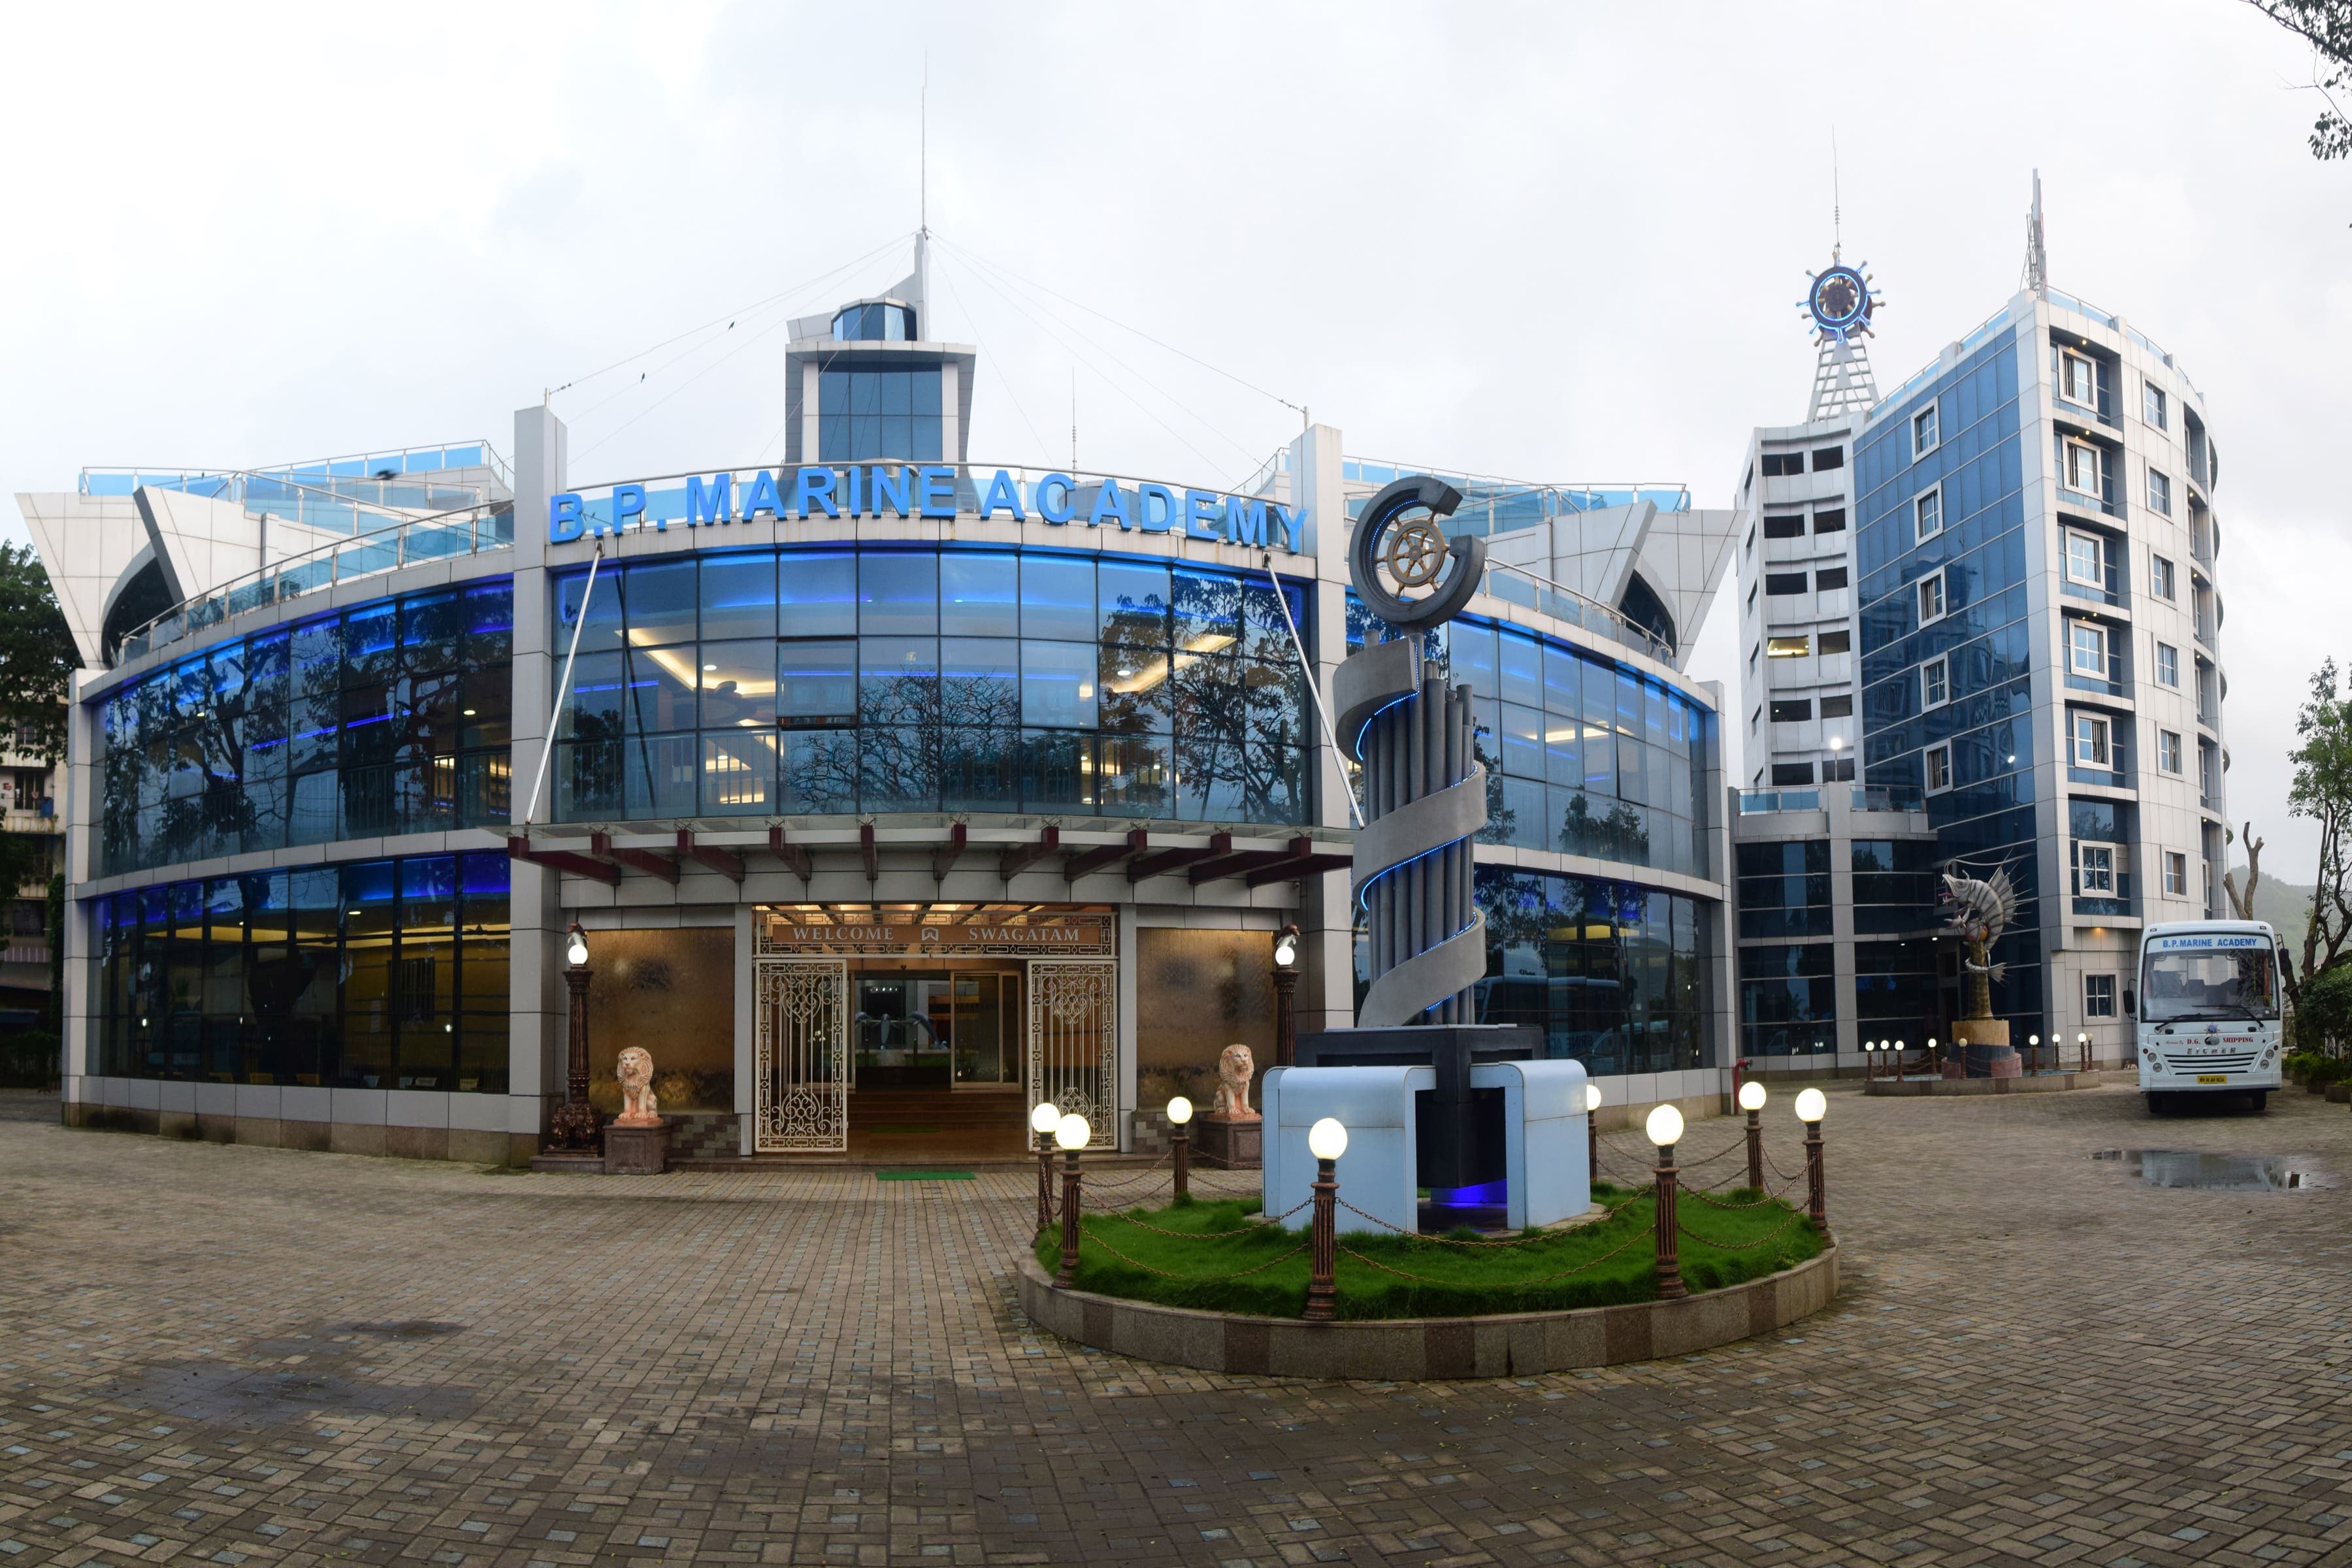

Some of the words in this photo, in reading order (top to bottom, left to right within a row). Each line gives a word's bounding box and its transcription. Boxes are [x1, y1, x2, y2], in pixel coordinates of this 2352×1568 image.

[550, 483, 667, 545] B.P.
[687, 466, 956, 527] MARINE
[980, 470, 1309, 555] ACADEMY
[792, 926, 894, 941] WELCOME
[969, 926, 1080, 941] SWAGATAM
[2217, 938, 2257, 947] ACADEMY
